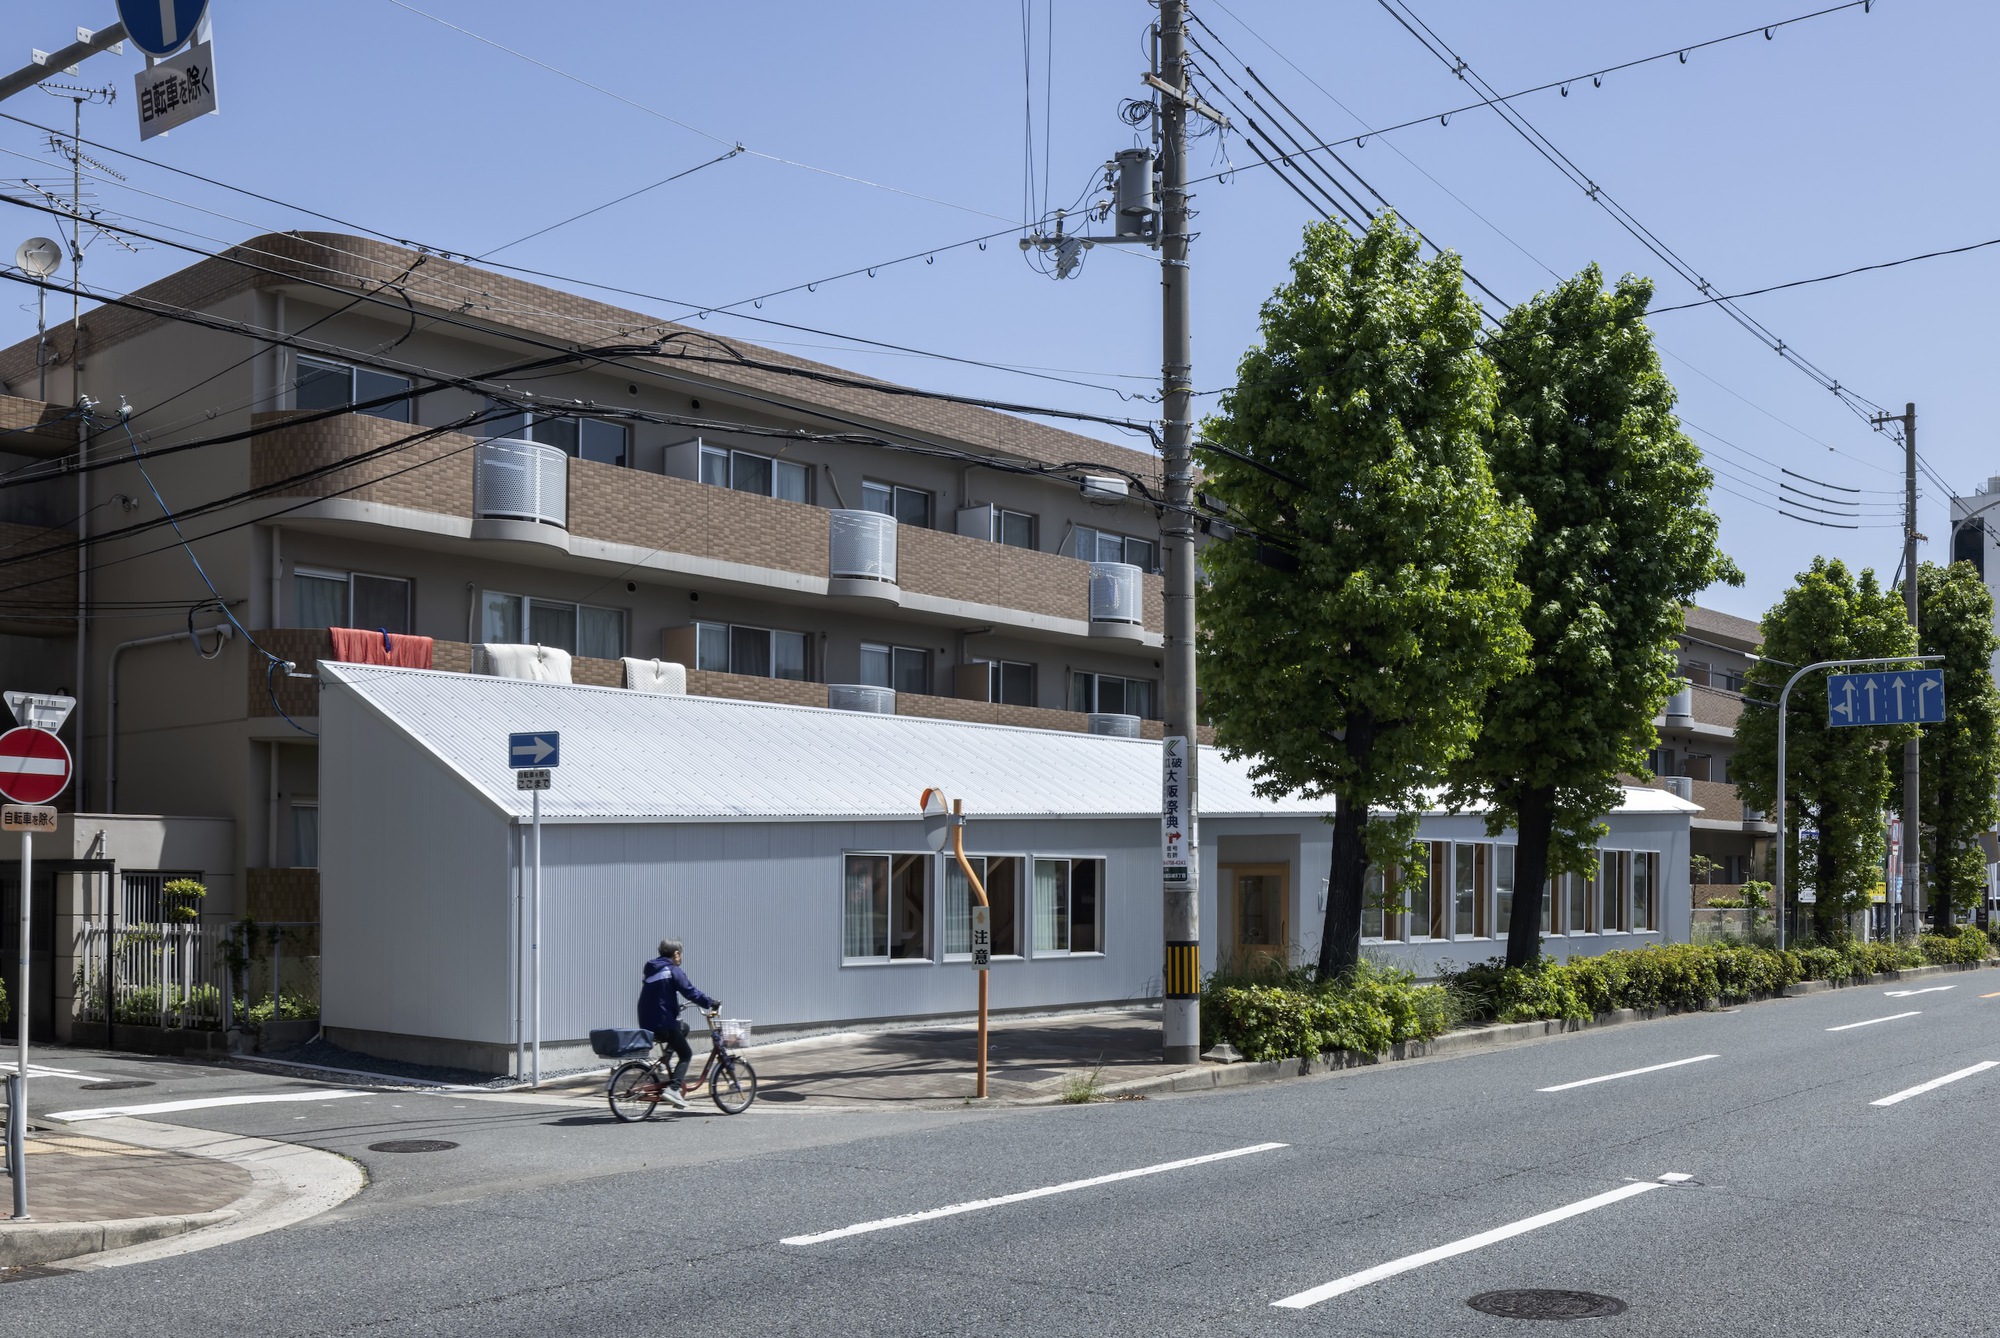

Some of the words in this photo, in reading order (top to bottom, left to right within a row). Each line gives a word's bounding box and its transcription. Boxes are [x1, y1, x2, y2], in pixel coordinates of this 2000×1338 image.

[141, 65, 210, 122] 自転車を除く
[518, 779, 550, 789] ここまで
[1166, 769, 1179, 829] 大阪祭典
[4, 811, 55, 826] 自転車を除く
[974, 930, 988, 965] 注意
